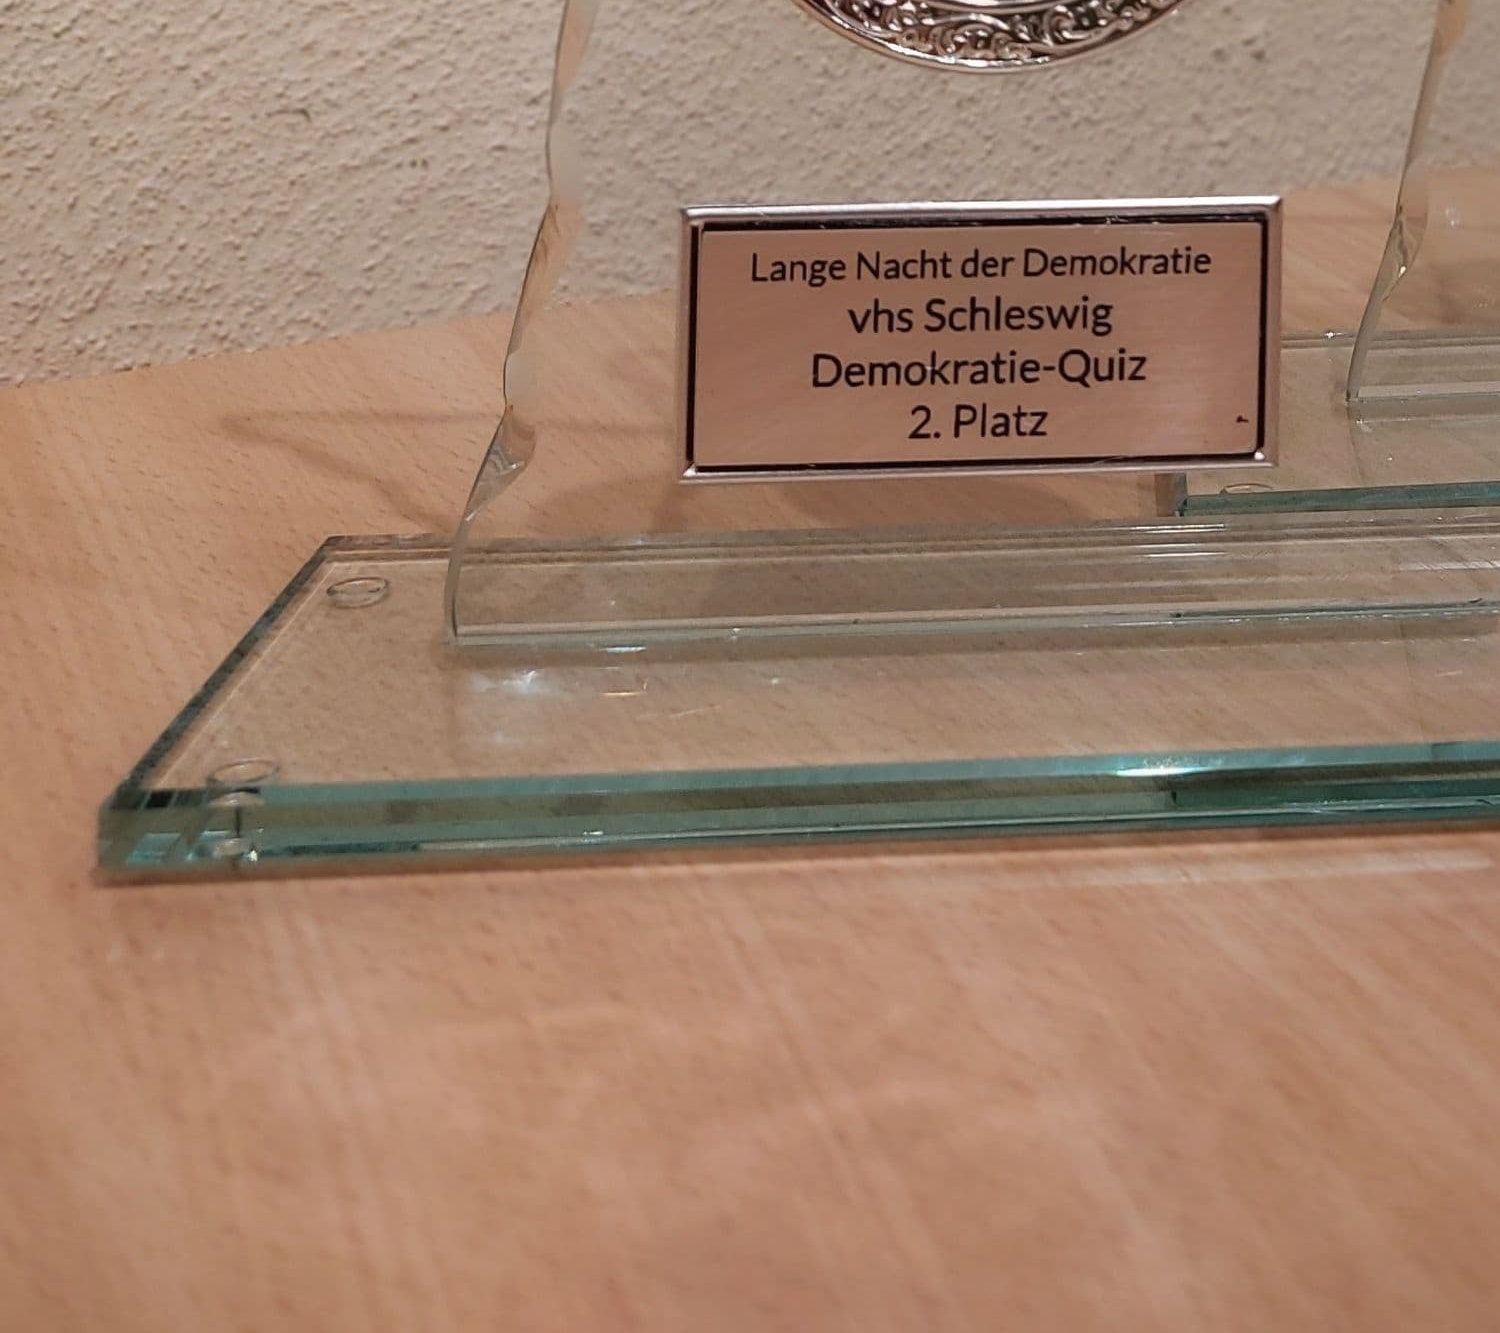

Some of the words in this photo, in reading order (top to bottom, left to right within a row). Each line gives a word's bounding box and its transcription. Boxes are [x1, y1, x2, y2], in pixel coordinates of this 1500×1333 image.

[751, 252, 846, 287] Lange
[856, 250, 952, 281] Nacht
[961, 249, 1014, 279] der
[1023, 246, 1212, 277] Demokratie
[848, 300, 913, 335] vhs
[924, 296, 1114, 337] Schleswig
[812, 348, 1147, 389] Demokratie-Quiz
[908, 405, 940, 439] 2.
[954, 403, 1048, 438] Platz
